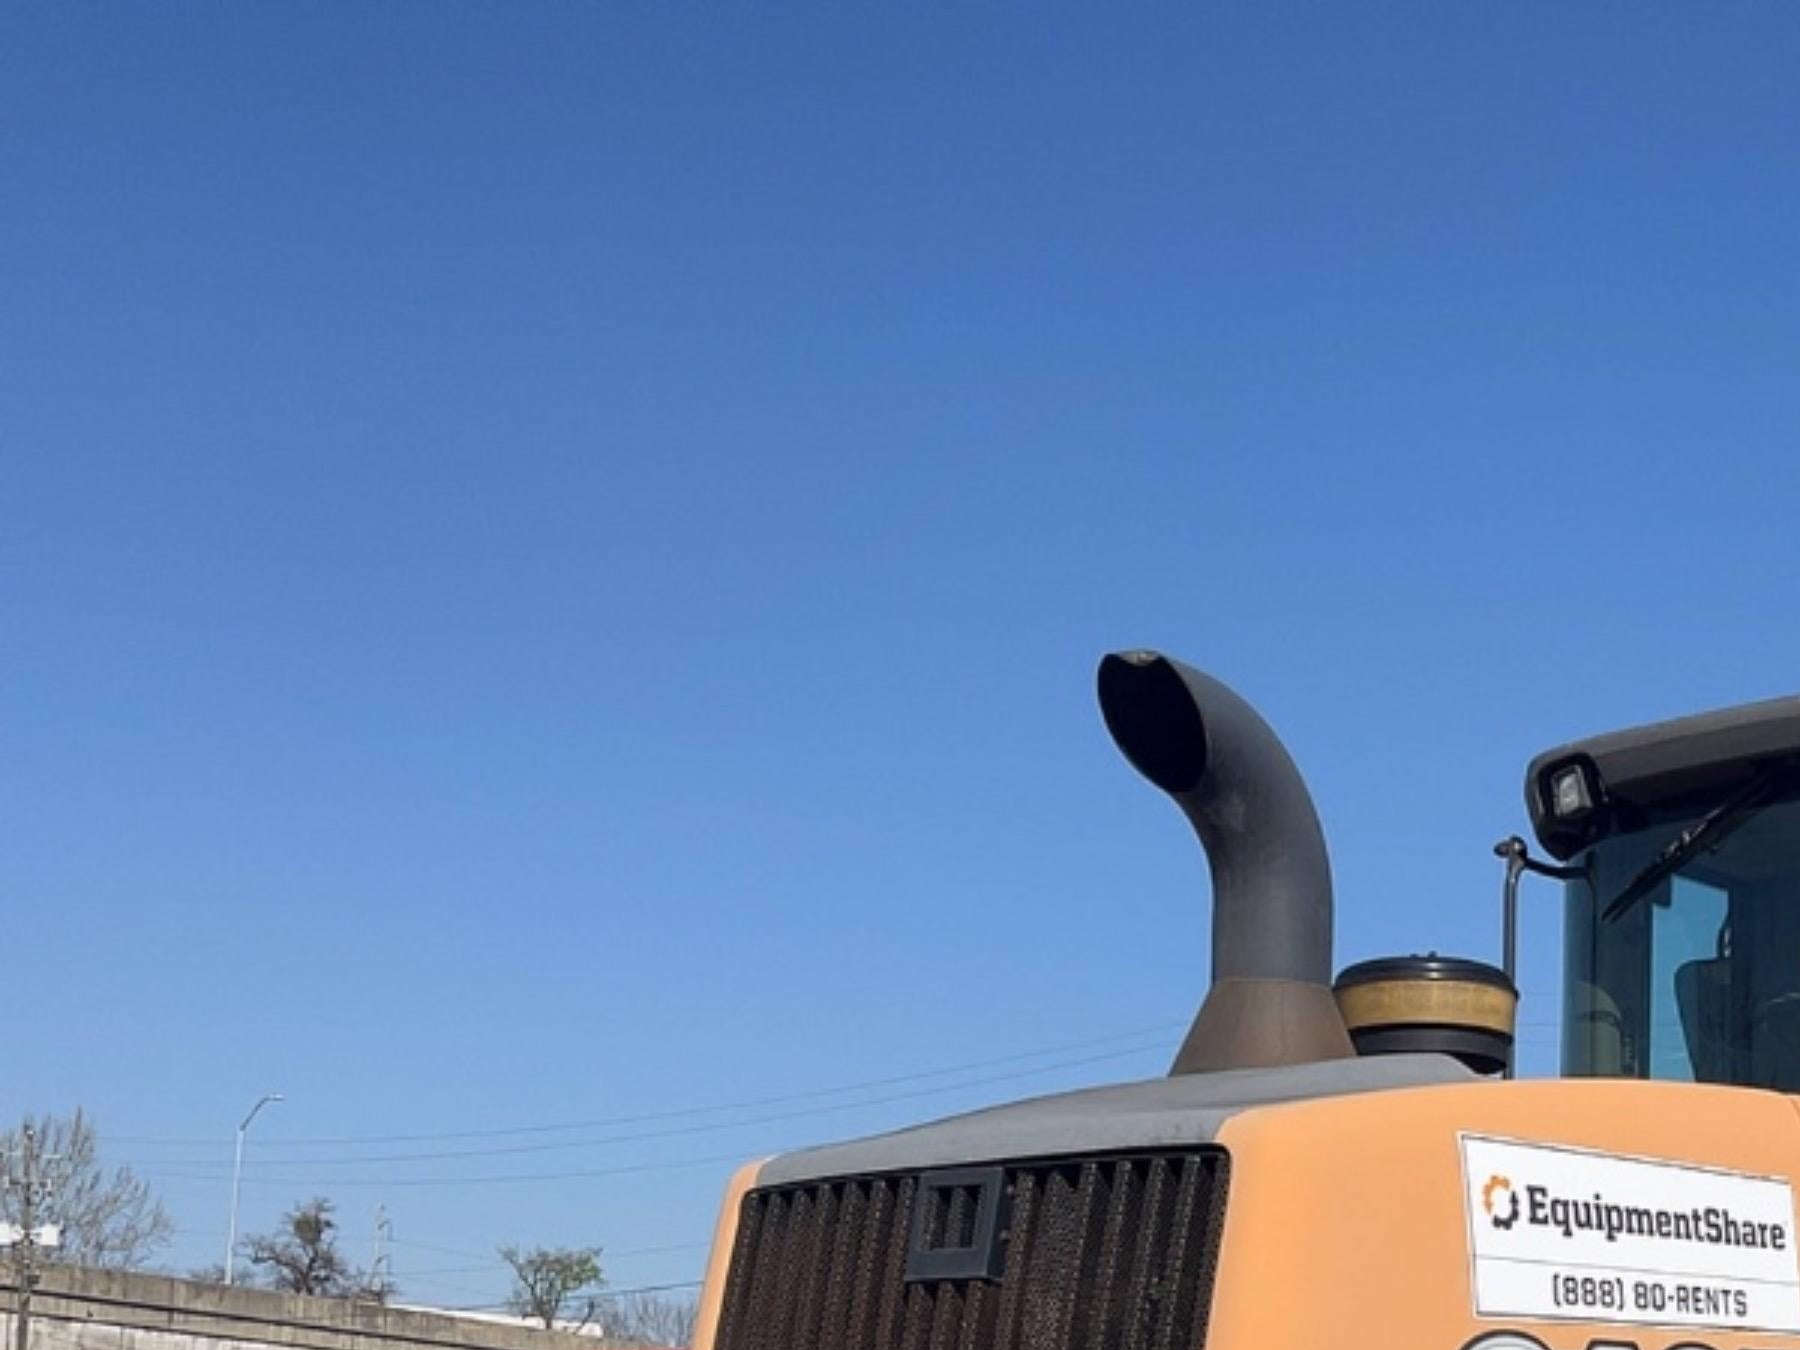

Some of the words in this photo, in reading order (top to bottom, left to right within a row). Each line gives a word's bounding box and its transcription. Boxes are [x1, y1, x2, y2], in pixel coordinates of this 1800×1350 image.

[1526, 1184, 1787, 1251] EquipmentShare
[1552, 1273, 1625, 1311] (888)
[1633, 1281, 1748, 1318] 80-RENTS
